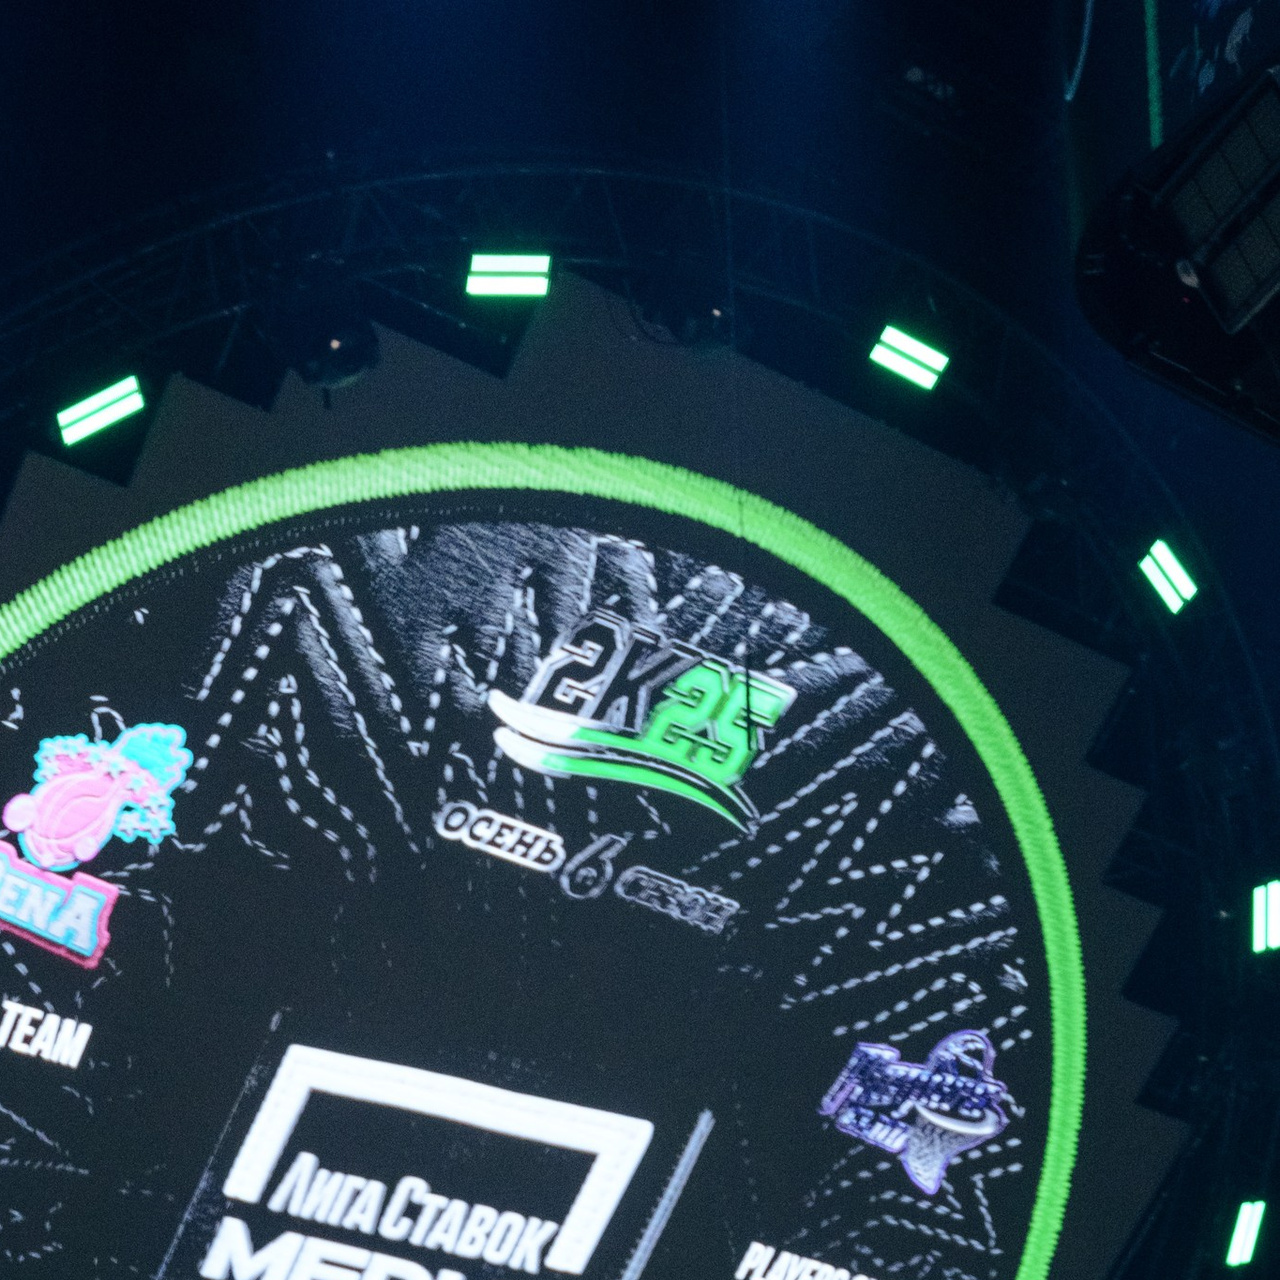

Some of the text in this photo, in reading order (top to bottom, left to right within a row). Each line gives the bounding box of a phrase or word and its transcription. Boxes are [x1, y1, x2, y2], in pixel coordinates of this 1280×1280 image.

[520, 605, 799, 786] 2K25
[436, 802, 565, 872] ОСЕНЬ
[560, 833, 628, 899] 6
